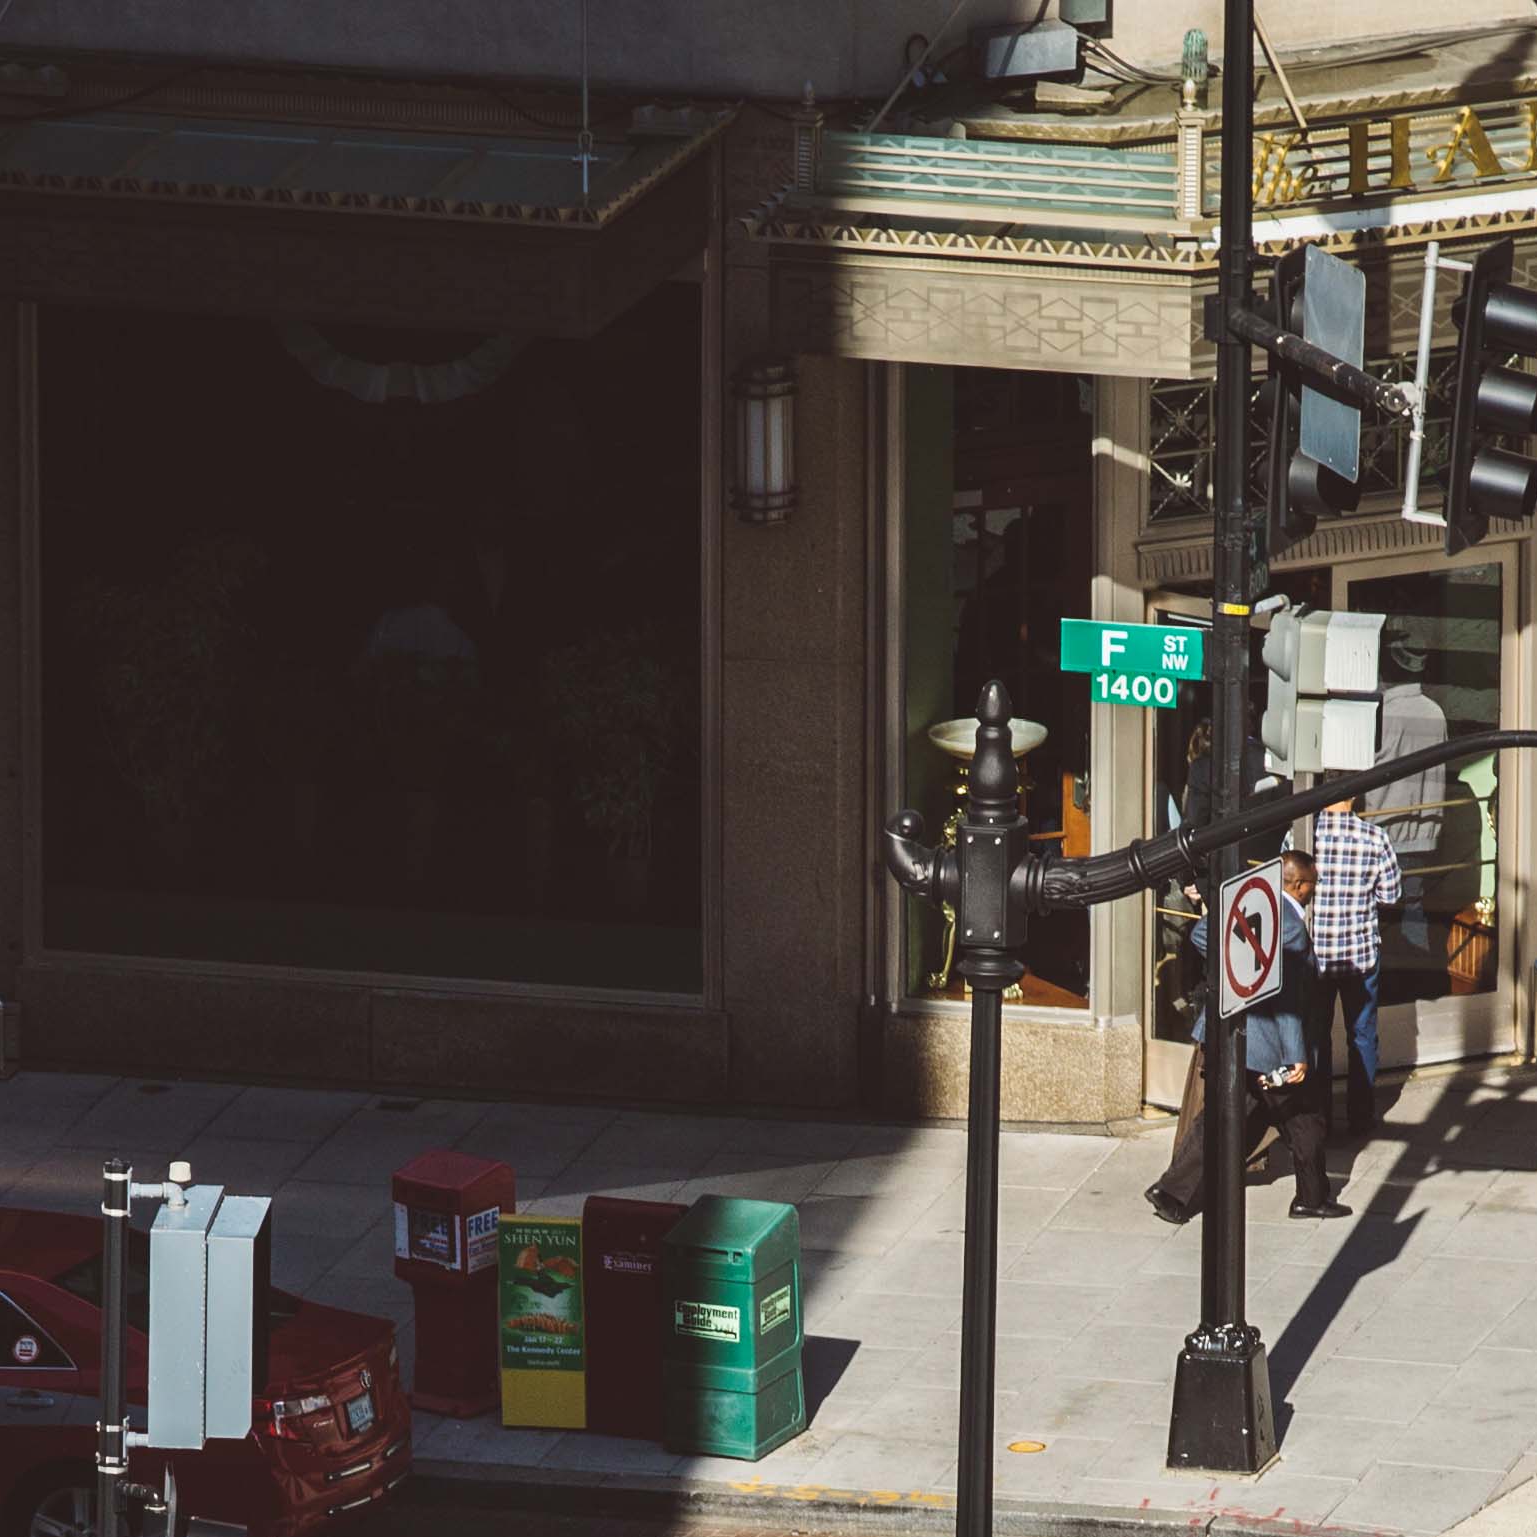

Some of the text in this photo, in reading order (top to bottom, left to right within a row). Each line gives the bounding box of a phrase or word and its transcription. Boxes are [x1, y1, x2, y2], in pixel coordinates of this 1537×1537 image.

[1101, 630, 1188, 666] F ST
[1162, 653, 1189, 671] NW
[1096, 674, 1174, 704] 1400
[468, 1210, 499, 1237] FREE
[504, 1232, 543, 1245] SHEN
[546, 1234, 576, 1246] YUN
[676, 1301, 738, 1319] Employment
